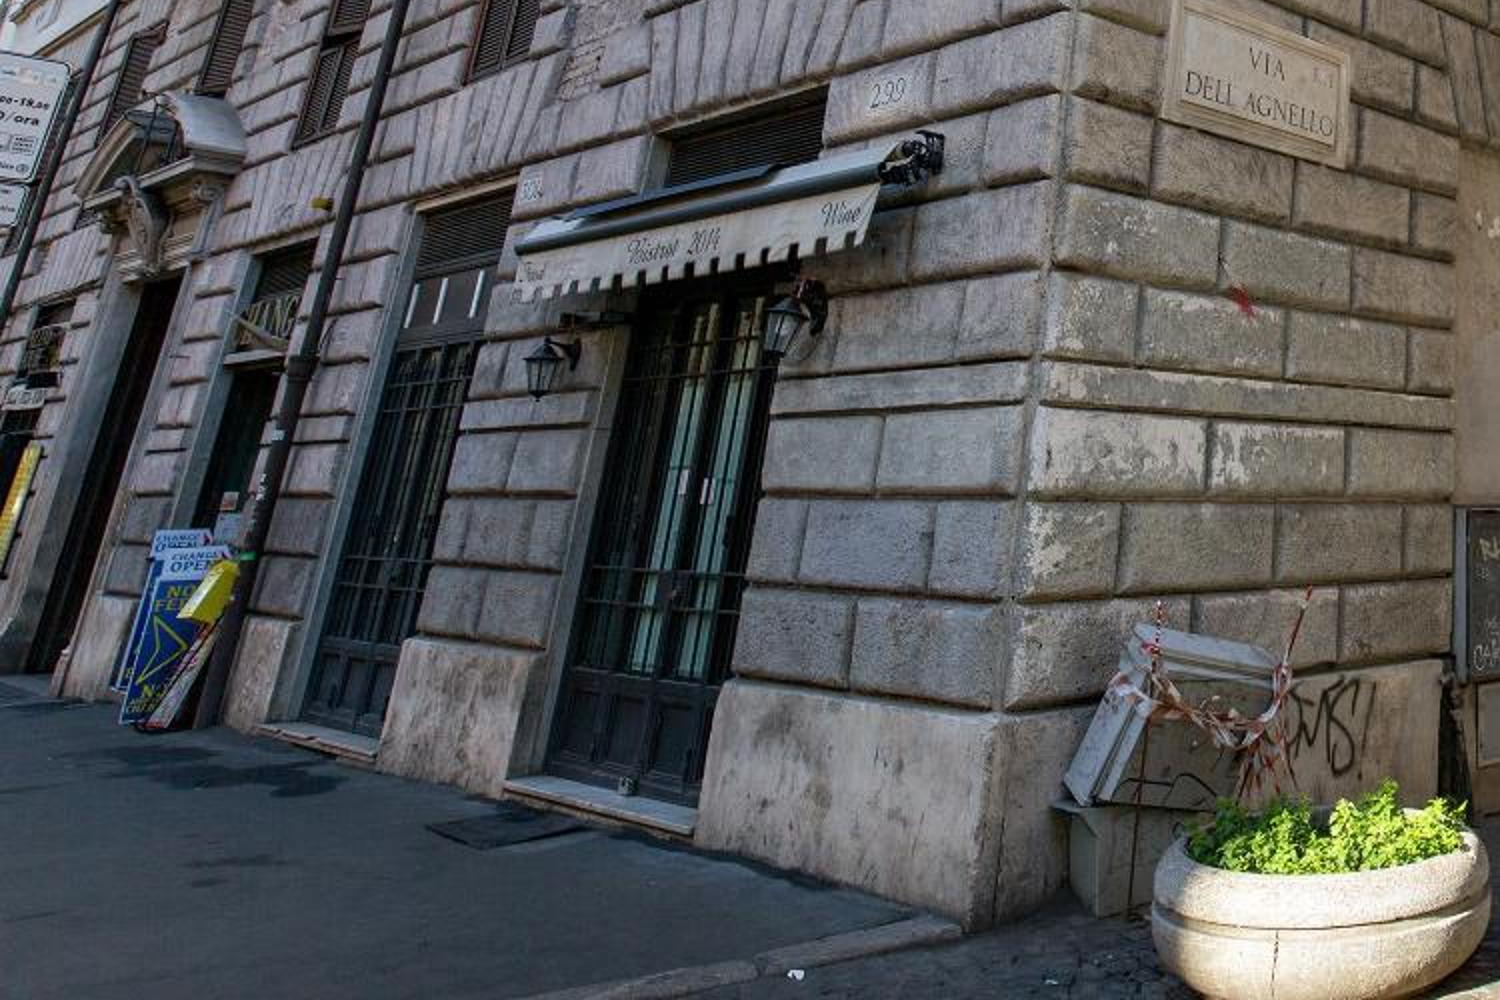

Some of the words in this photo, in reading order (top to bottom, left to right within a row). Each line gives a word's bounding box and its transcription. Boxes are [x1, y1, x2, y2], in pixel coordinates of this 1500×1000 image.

[1248, 45, 1286, 81] VIA
[1243, 92, 1334, 137] AGNELLO
[820, 200, 862, 227] Wine
[686, 227, 721, 256] 2014
